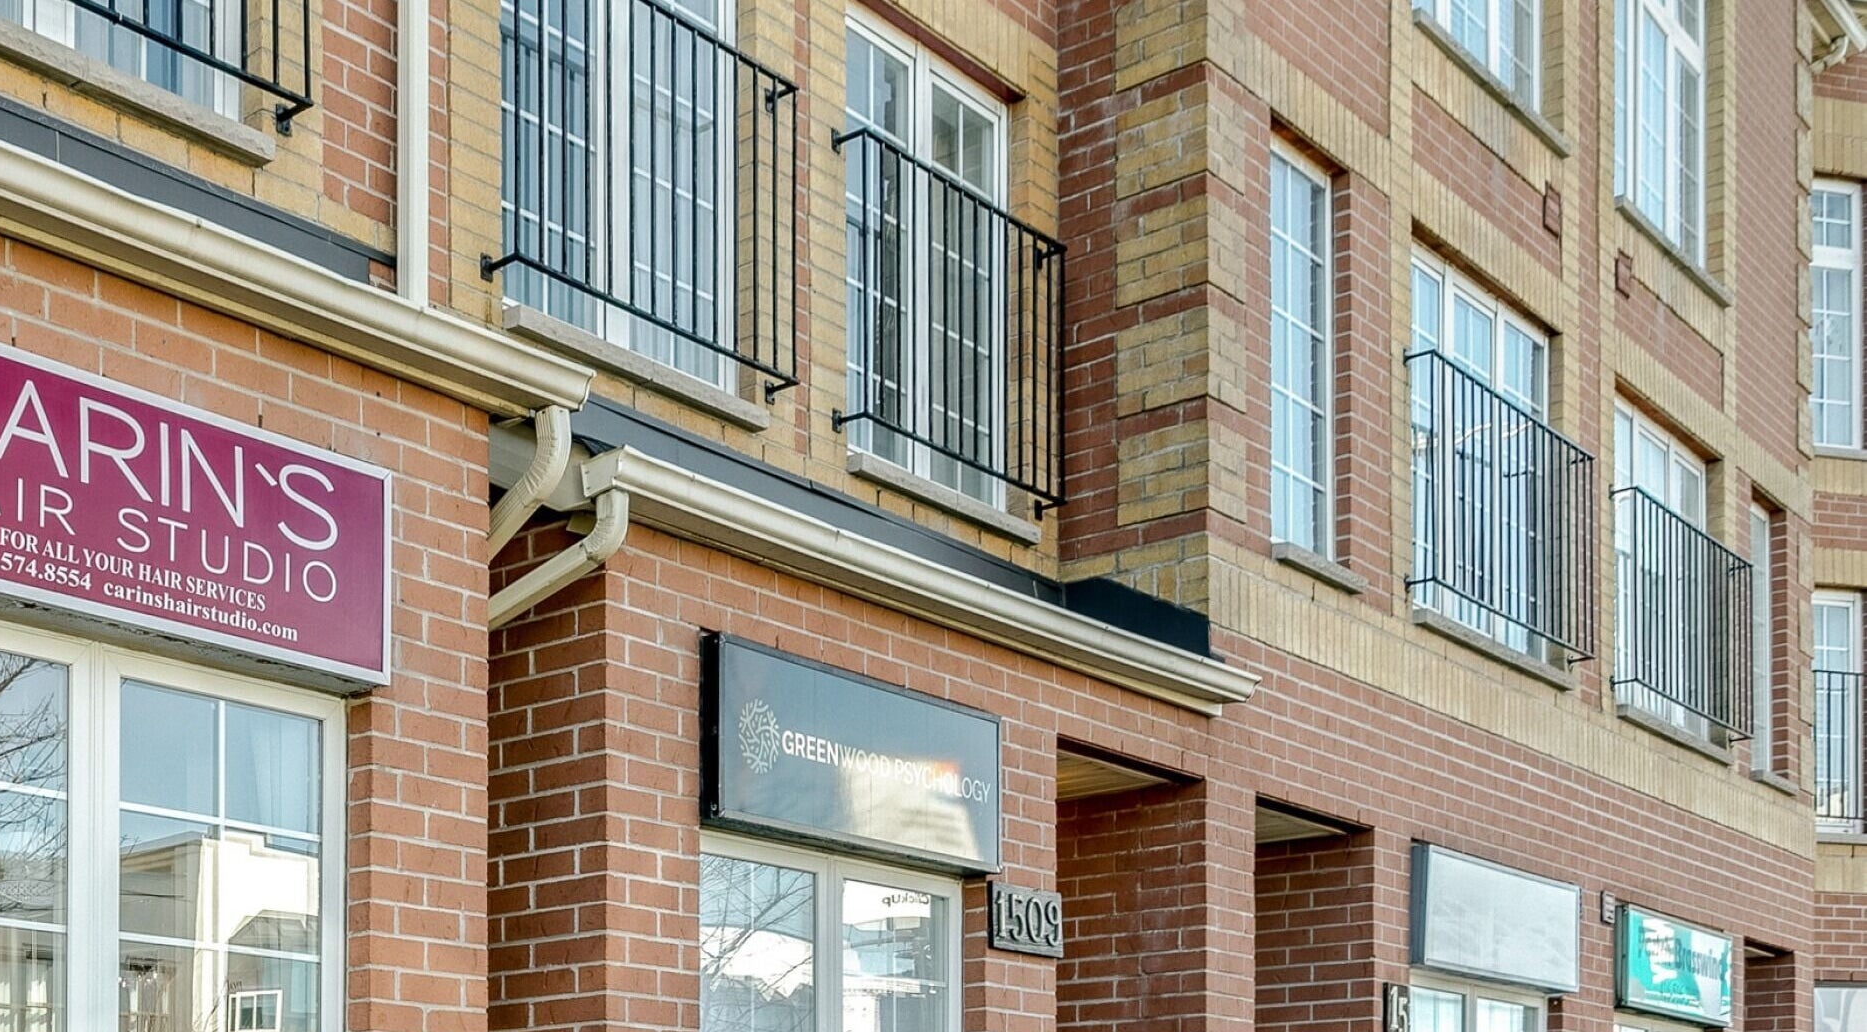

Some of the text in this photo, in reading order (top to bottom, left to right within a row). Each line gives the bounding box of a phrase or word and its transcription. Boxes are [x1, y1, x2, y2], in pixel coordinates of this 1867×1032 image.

[0, 527, 266, 612] FOR ALL YOUR HAIR SERVICES
[117, 508, 336, 603] STUDIO
[103, 581, 299, 642] carinshairstudio.com
[782, 730, 992, 804] GREENWOOD PSYCHOLOGY
[995, 890, 1061, 947] 1509
